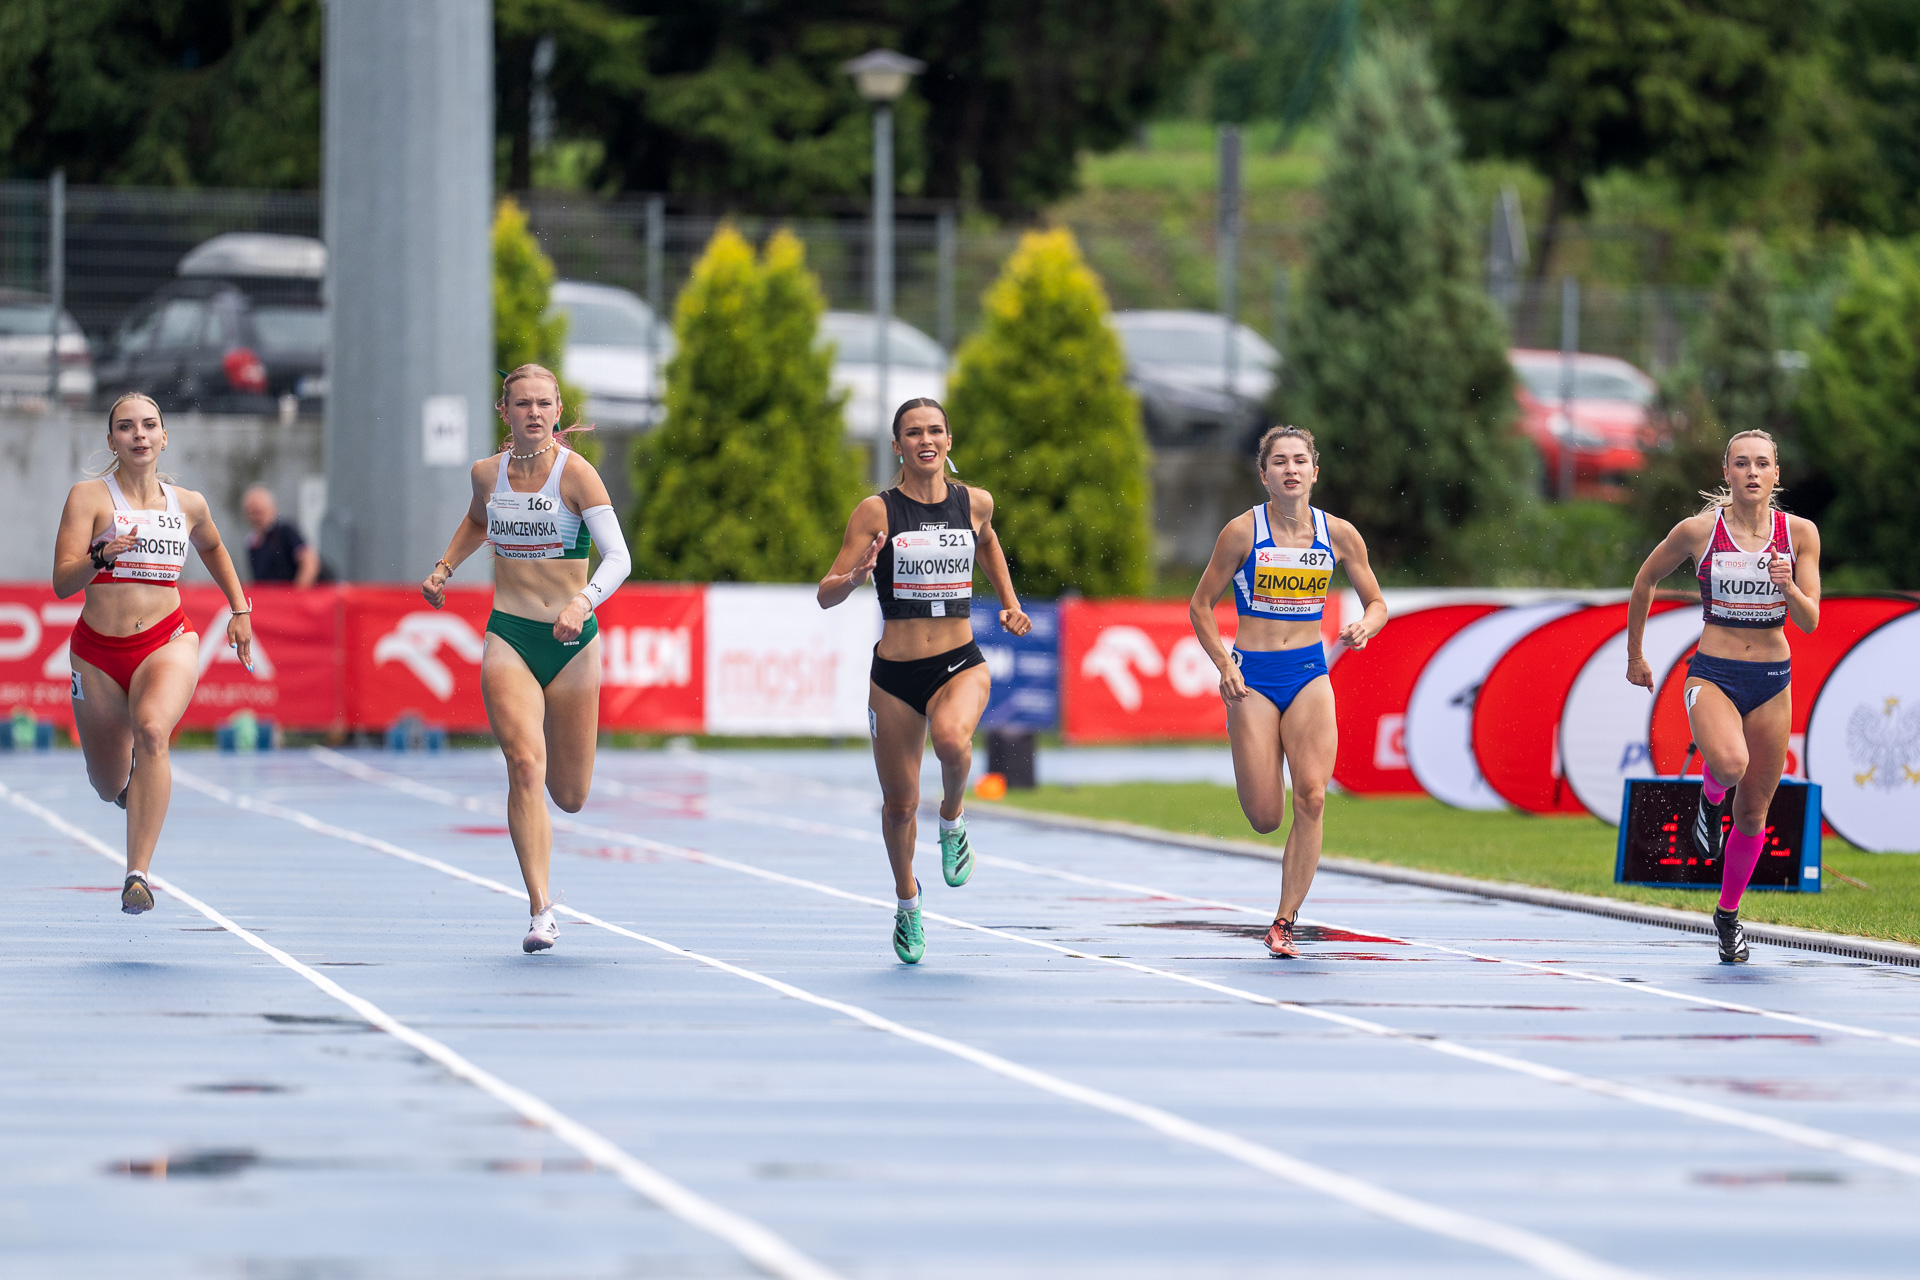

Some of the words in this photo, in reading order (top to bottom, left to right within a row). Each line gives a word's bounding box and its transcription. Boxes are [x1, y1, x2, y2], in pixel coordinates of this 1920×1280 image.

[527, 497, 553, 511] 160
[158, 515, 181, 529] 519
[489, 520, 558, 537] ADAMCZEWSKA
[921, 524, 947, 532] NIKE
[128, 538, 186, 557] ROSTEK
[939, 534, 968, 547] 521
[897, 557, 970, 575] ŻUKOWSKA
[1299, 552, 1327, 566] 487
[131, 570, 158, 578] RADOM
[1257, 574, 1328, 593] ZIMOLĄG
[1719, 579, 1781, 595] KUDZIA
